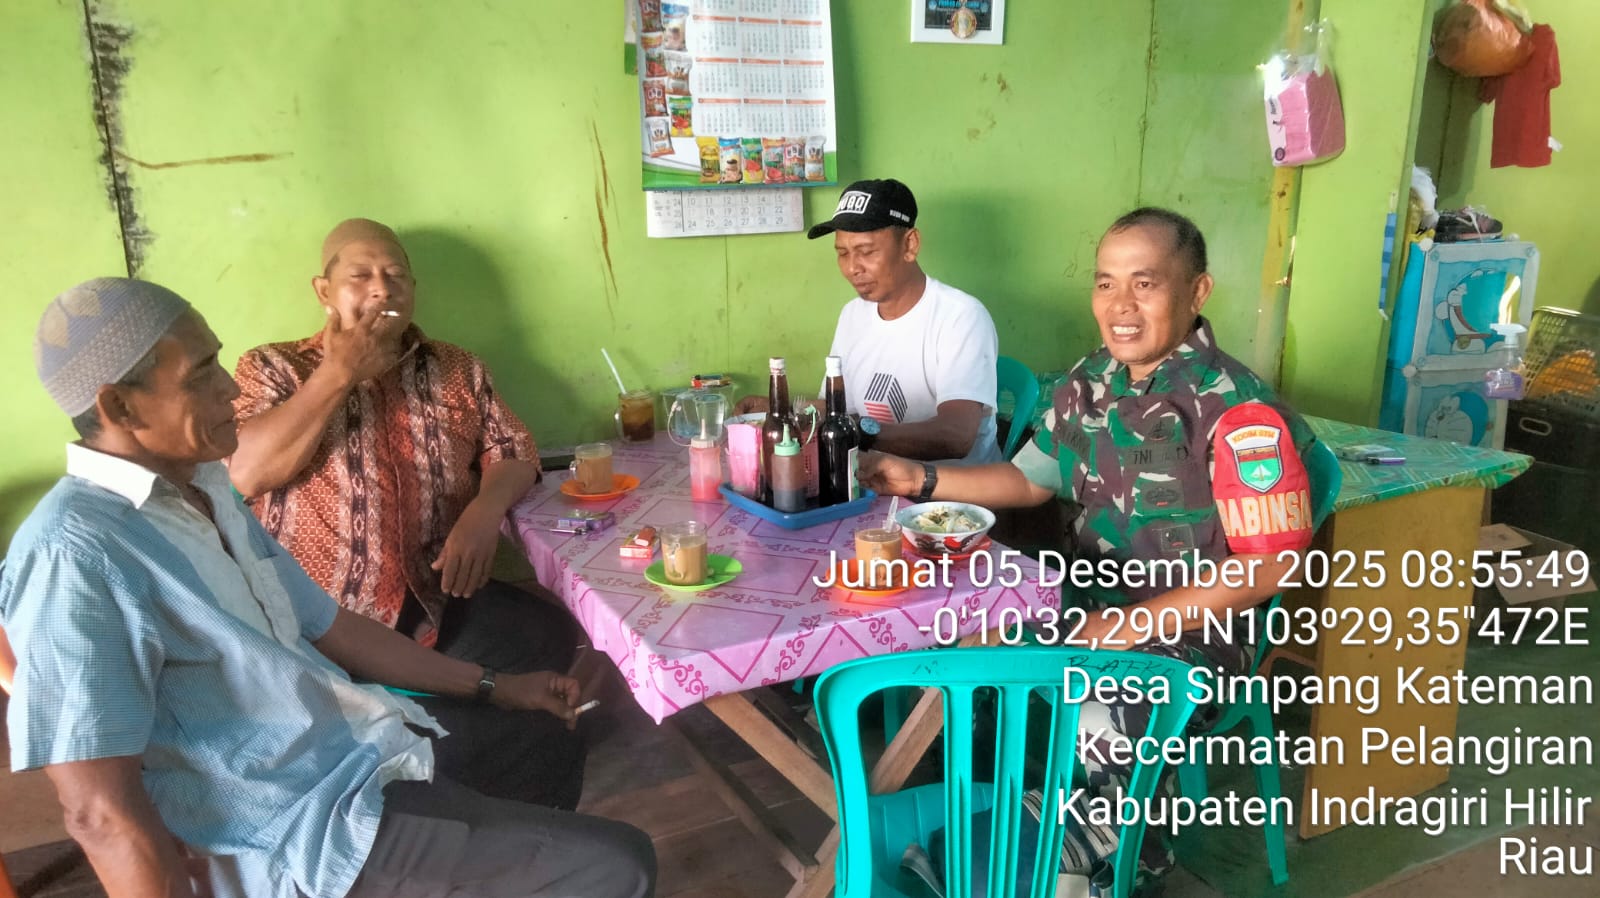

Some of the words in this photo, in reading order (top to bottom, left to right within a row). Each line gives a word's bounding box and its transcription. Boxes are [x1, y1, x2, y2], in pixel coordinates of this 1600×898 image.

[775, 206, 783, 214] 22
[687, 220, 697, 229] 24
[705, 219, 715, 228] 25
[723, 218, 733, 227] 26
[775, 217, 784, 225] 29
